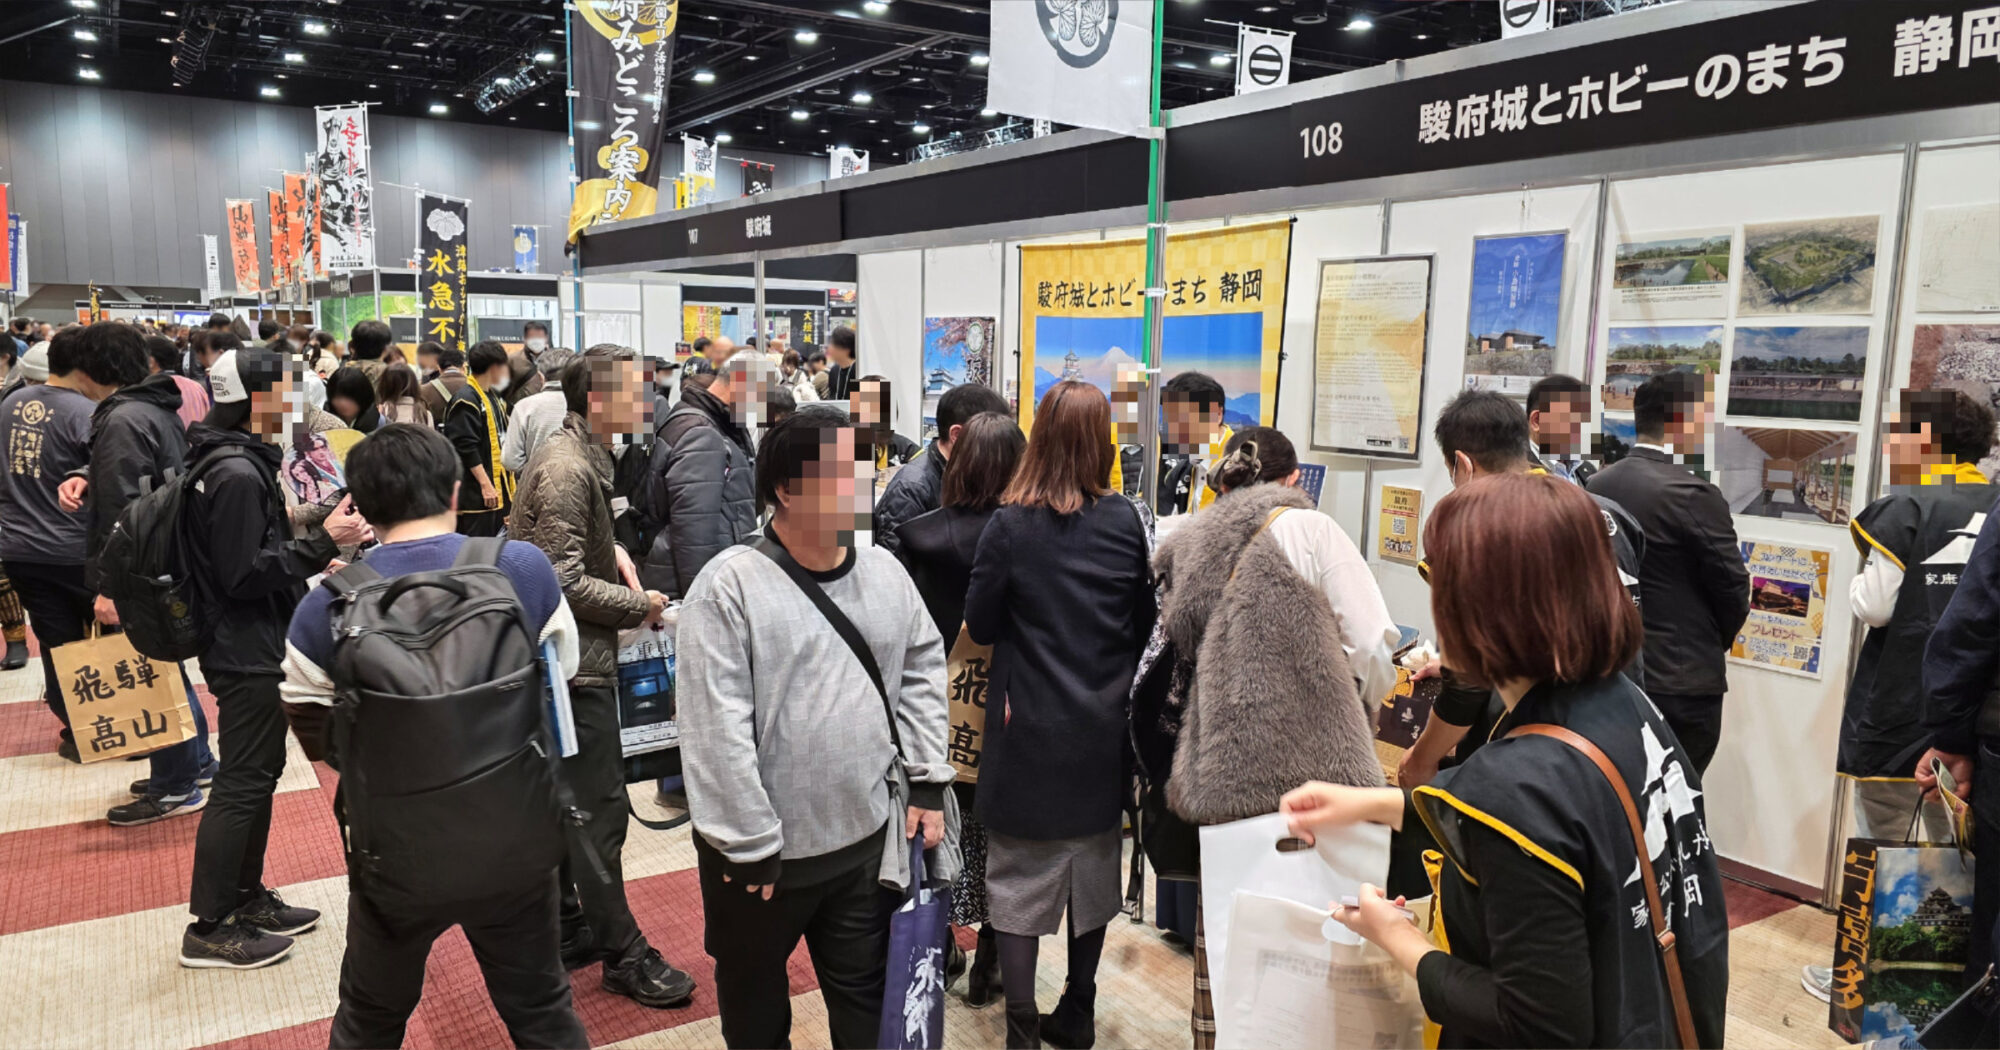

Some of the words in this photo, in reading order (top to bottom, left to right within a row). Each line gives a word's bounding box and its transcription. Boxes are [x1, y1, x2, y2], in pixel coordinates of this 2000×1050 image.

[1418, 35, 1848, 144] 駿府城とホビーのまち
[1893, 5, 2000, 77] 静岡
[1300, 122, 1343, 158] 108
[745, 214, 772, 239] 駿府城
[426, 248, 456, 344] 水急不
[1037, 275, 1206, 309] 駿府城とホビーまち
[1219, 268, 1263, 303] 静岡
[1925, 572, 1962, 586] 家康
[72, 654, 160, 705] 飛騨
[89, 708, 168, 754] 高山
[948, 720, 982, 769] 高
